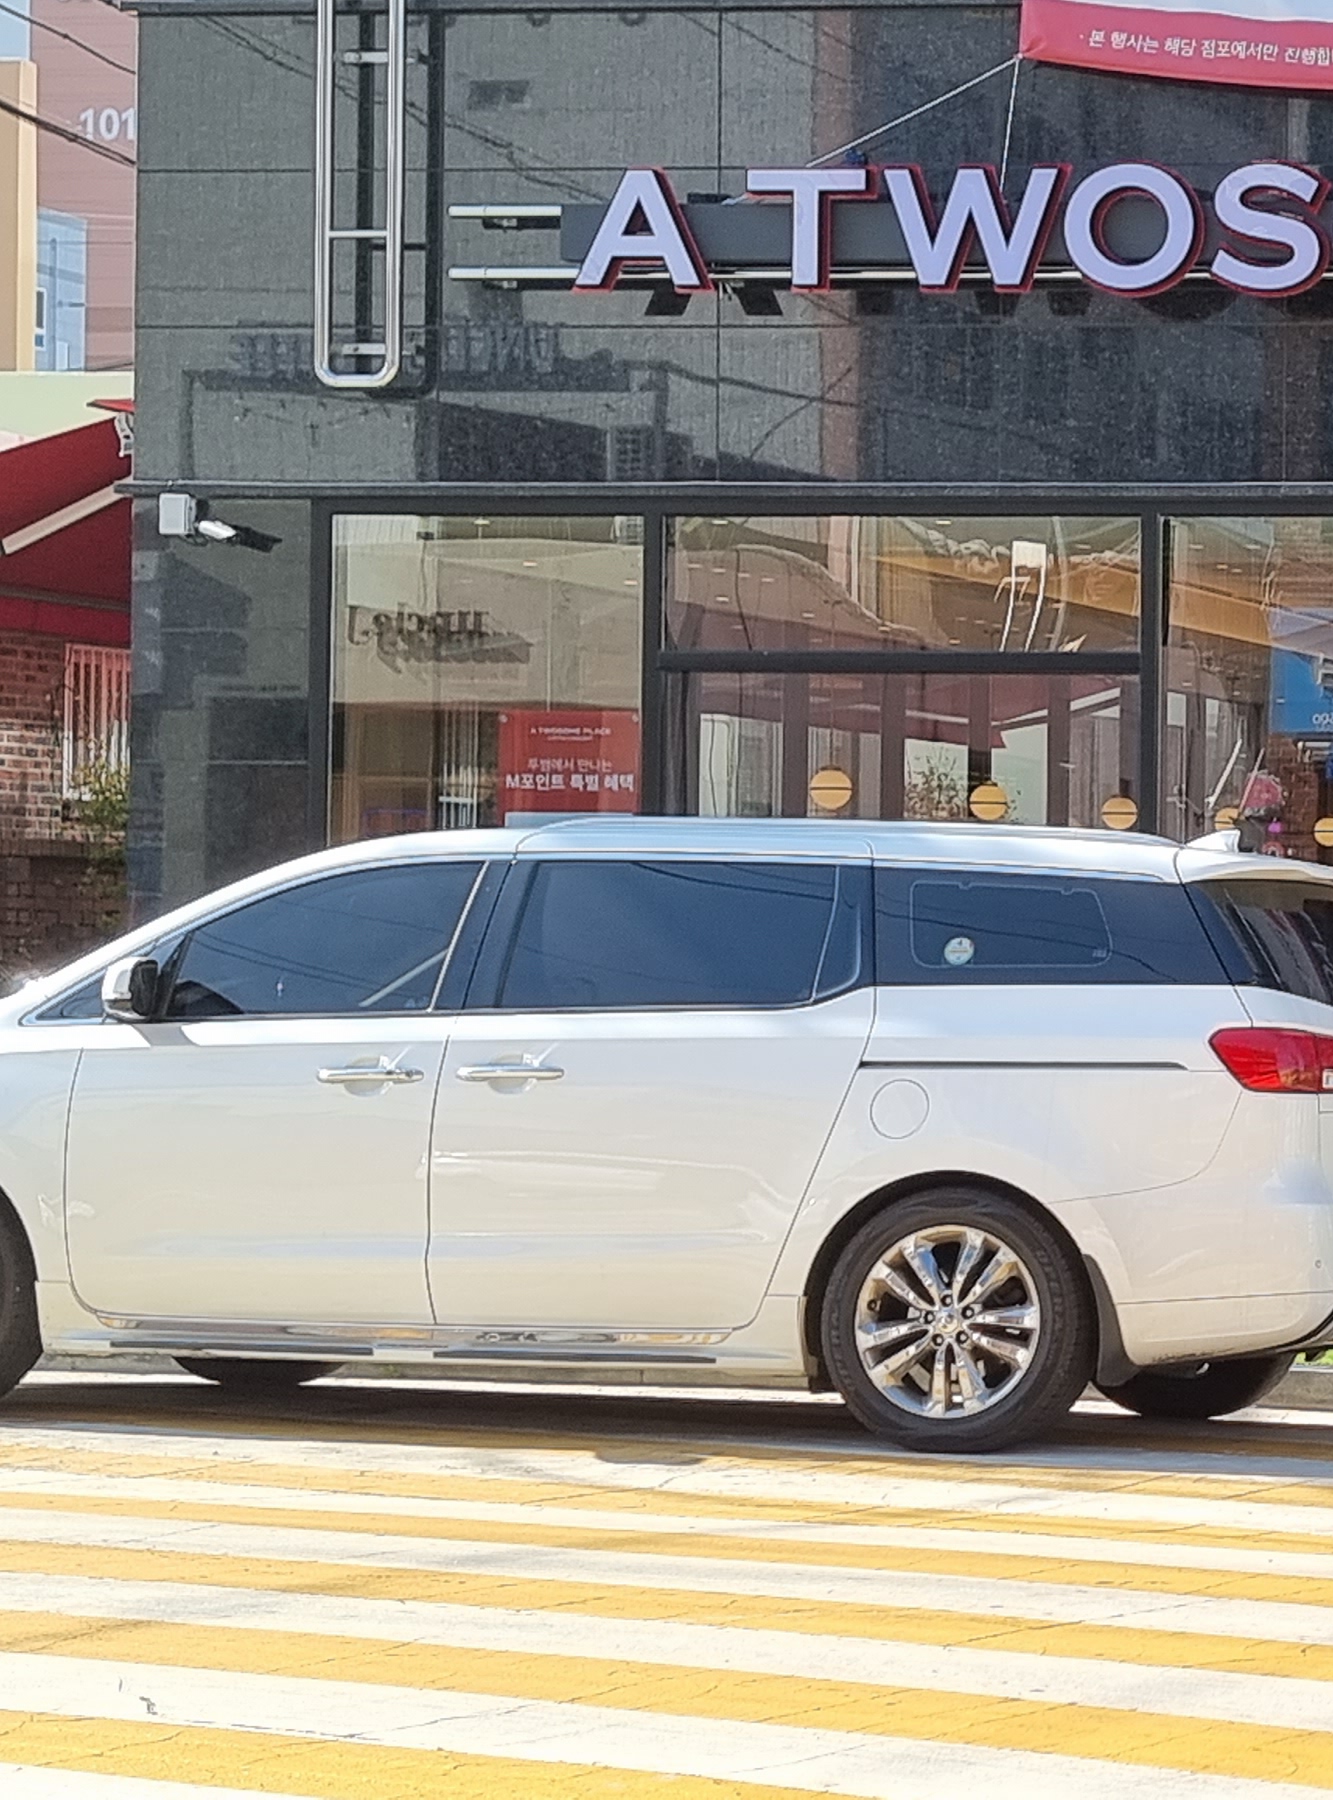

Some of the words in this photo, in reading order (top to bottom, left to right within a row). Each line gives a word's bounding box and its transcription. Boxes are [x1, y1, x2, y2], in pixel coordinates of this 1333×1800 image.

[1088, 29, 1106, 48] 본
[1110, 31, 1161, 54] 행사는
[1163, 37, 1197, 57] 해당
[1200, 39, 1280, 62] 점포에서만
[574, 164, 714, 293] A
[576, 757, 614, 772] 만나는
[505, 772, 567, 792] M포인트
[569, 773, 600, 792] 특별
[603, 773, 635, 793] 혜택
